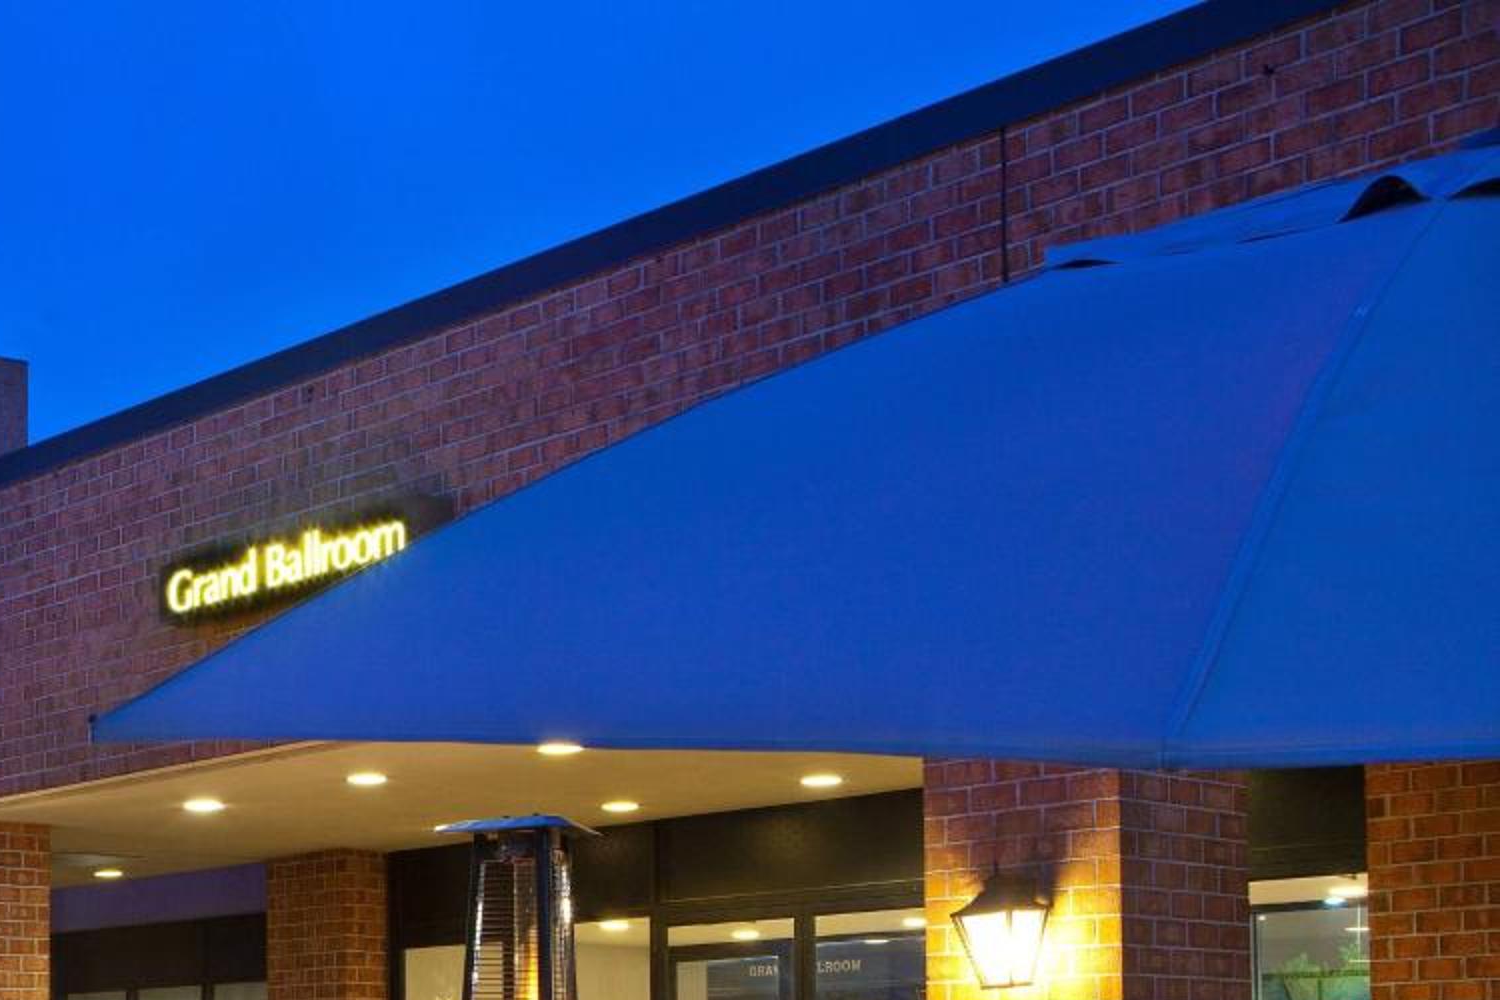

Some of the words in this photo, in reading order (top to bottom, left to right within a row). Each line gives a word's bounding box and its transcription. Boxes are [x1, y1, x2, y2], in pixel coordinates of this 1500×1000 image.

[166, 546, 258, 613] Grand
[264, 519, 406, 588] Ballroom
[749, 962, 779, 977] GRAN
[816, 959, 861, 974] LROOM
